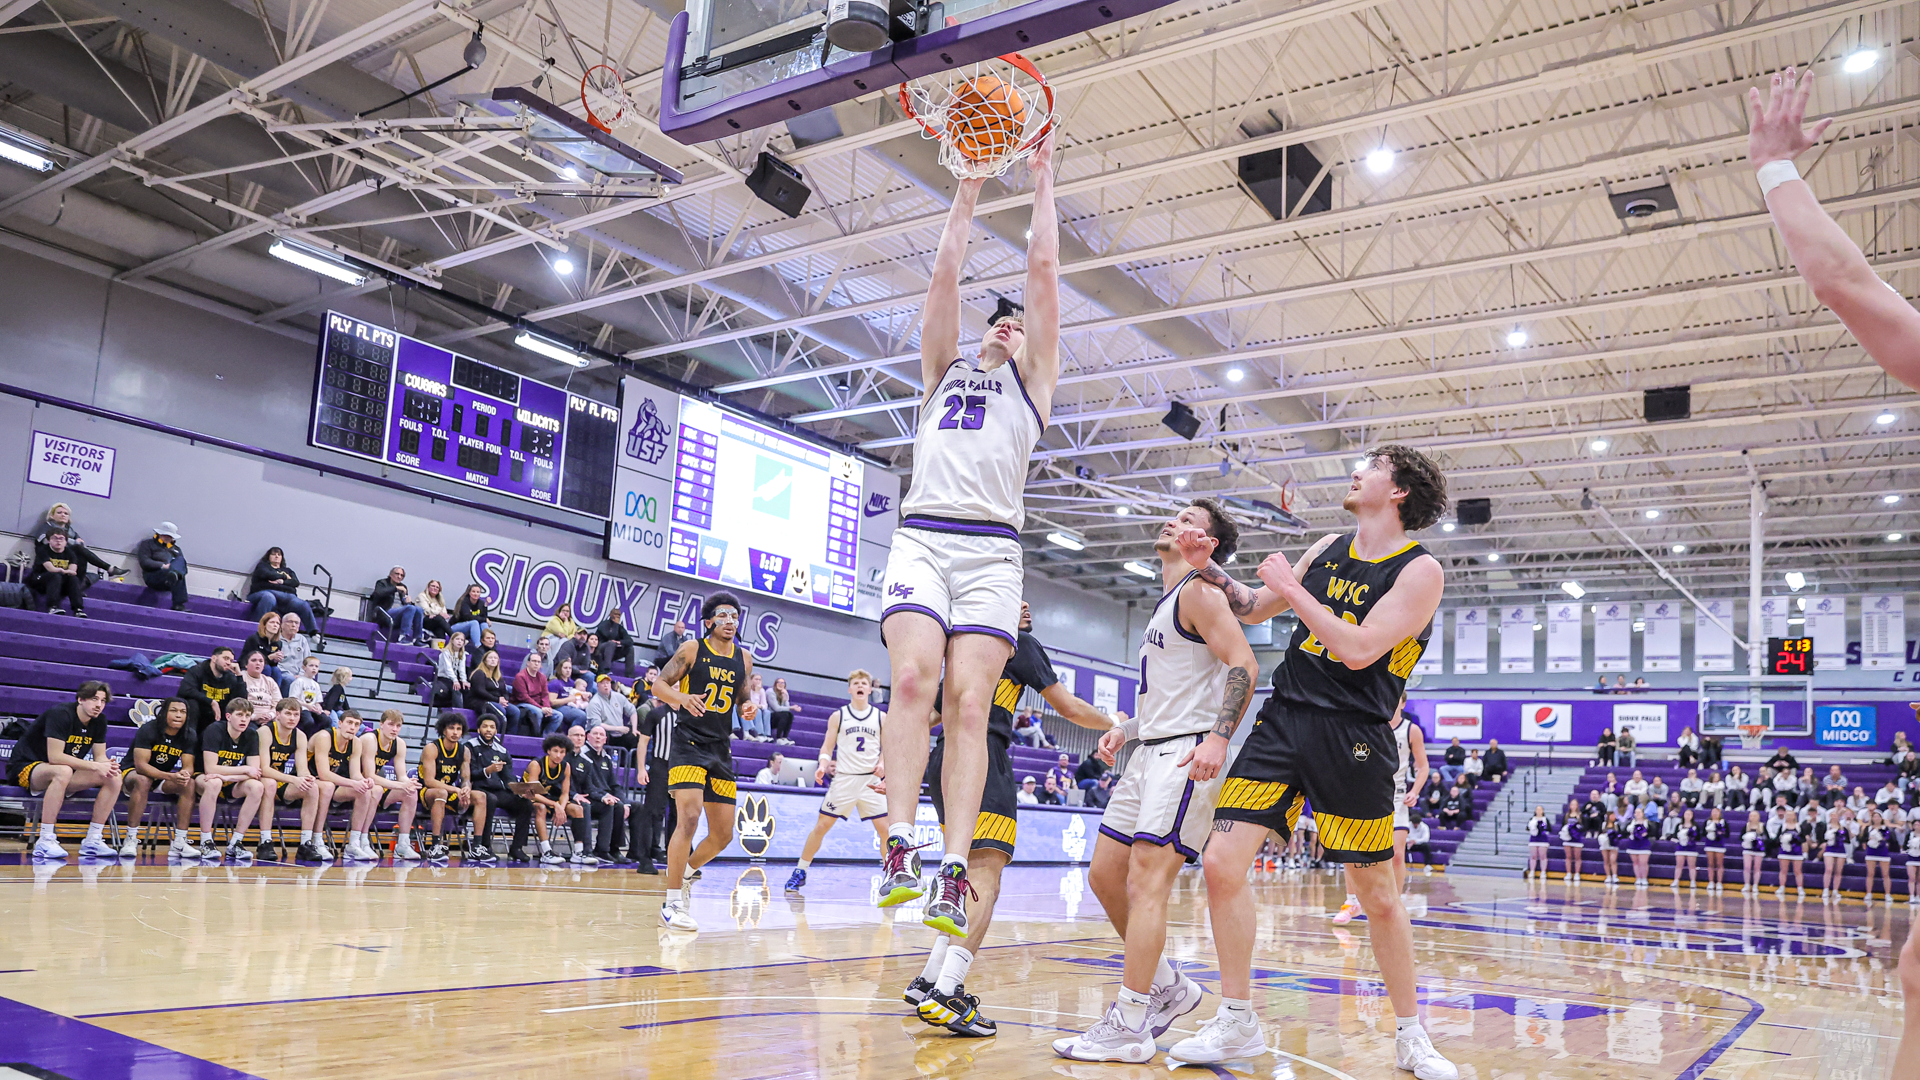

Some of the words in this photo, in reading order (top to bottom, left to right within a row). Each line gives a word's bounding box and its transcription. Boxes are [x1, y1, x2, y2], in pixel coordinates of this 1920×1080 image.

[329, 315, 351, 334] PLY
[356, 321, 370, 338] FL
[372, 329, 394, 349] PTS
[404, 373, 448, 398] COUGARS
[968, 380, 1002, 395] FALLS
[472, 400, 497, 416] PERIOD
[569, 395, 586, 412] PLY
[588, 402, 600, 416] FL
[600, 406, 618, 423] PTS
[938, 394, 986, 430] 25
[399, 418, 423, 434] FOULS
[516, 408, 560, 433] WILDCATS
[431, 426, 449, 441] T.O.L.
[45, 437, 106, 461] VISITORS
[458, 434, 484, 452] PLAYER
[485, 443, 503, 456] FOUL
[625, 432, 669, 465] USF
[43, 451, 103, 473] SECTION
[395, 452, 421, 467] SCORE
[509, 449, 526, 462] T.O.L.
[533, 456, 554, 470] FOULS
[465, 472, 489, 486] MATCH
[530, 488, 551, 502] SCORE
[869, 492, 891, 511] NIKE
[613, 521, 664, 549] MIDCO
[470, 547, 648, 640] SIOUX
[888, 582, 914, 599] USF
[1326, 576, 1370, 606] WSC
[1775, 651, 1805, 673] 24
[709, 666, 735, 683] WSC
[704, 682, 734, 714] 25
[845, 726, 861, 735] SIOUX
[861, 726, 876, 737] FALLS
[1822, 729, 1869, 741] MIDCO
[856, 736, 865, 752] 2
[272, 751, 290, 762] WSC
[441, 765, 457, 774] WSC
